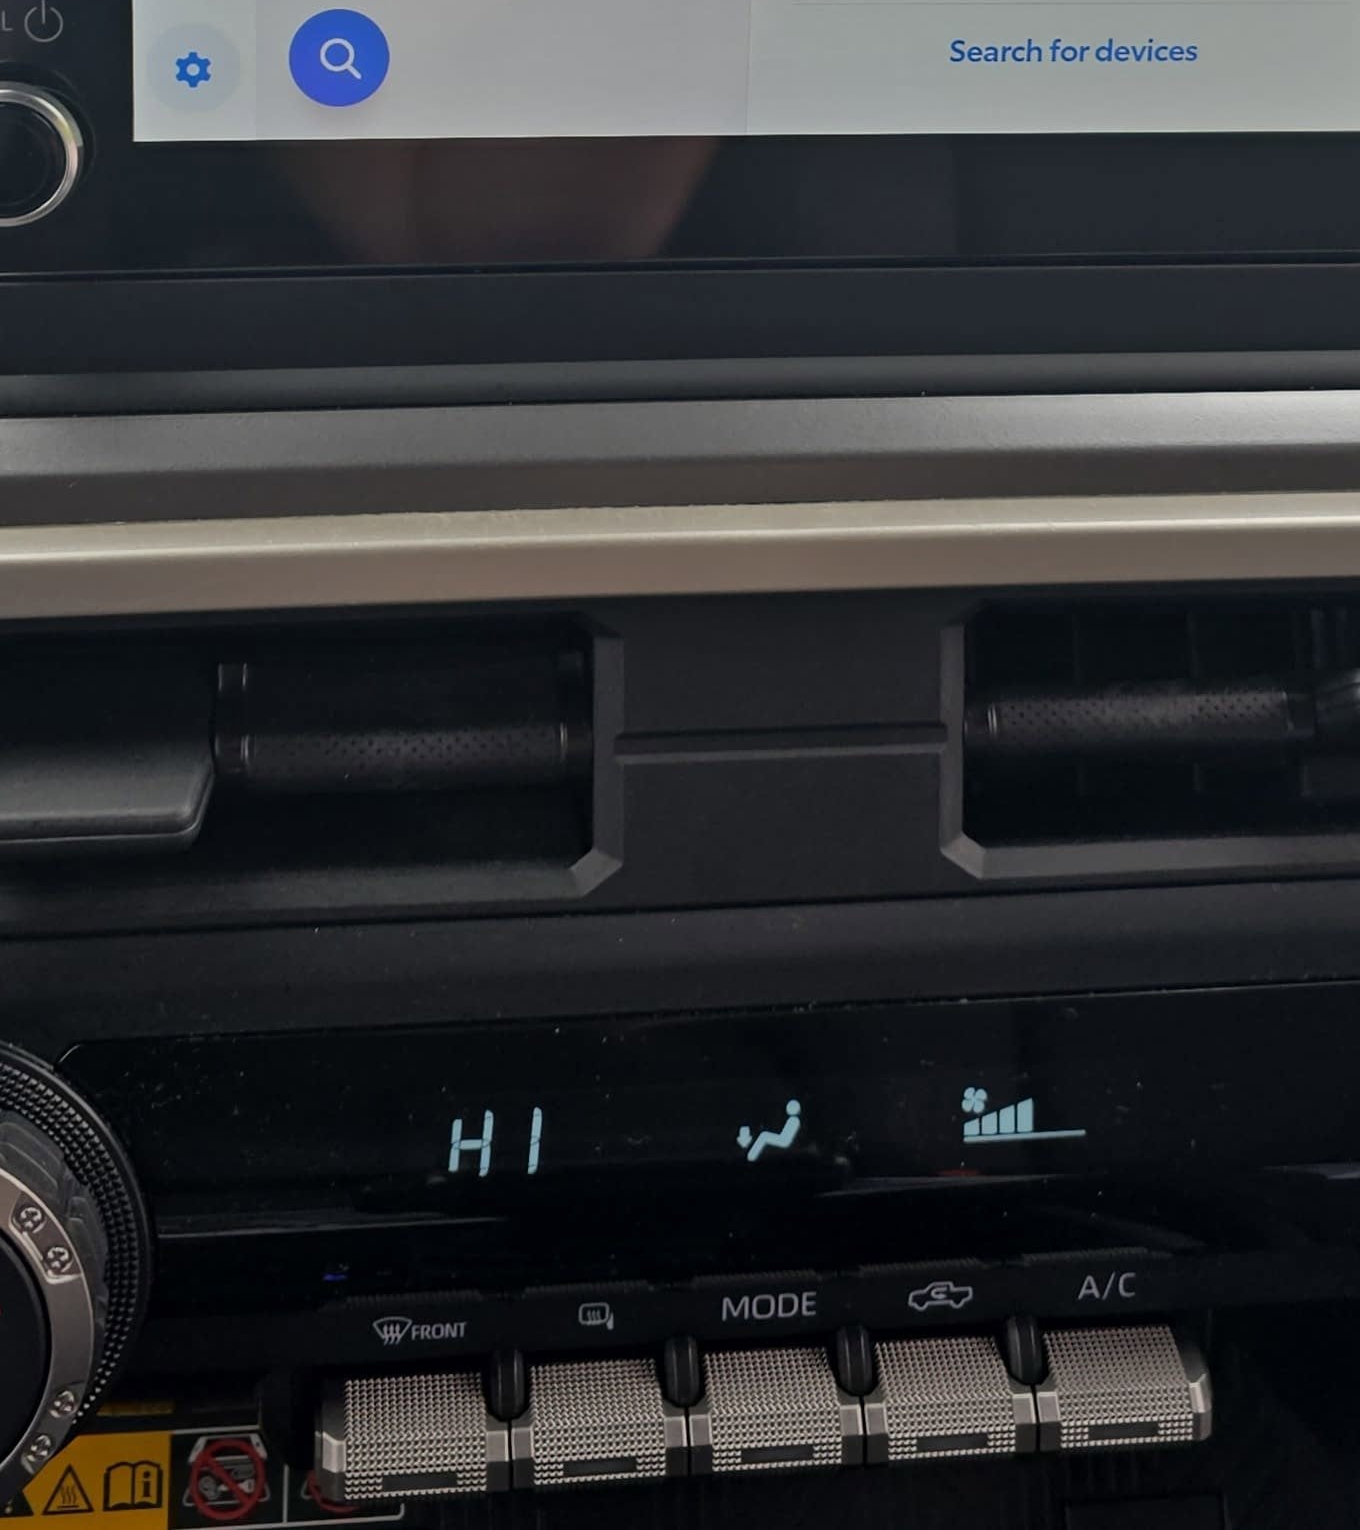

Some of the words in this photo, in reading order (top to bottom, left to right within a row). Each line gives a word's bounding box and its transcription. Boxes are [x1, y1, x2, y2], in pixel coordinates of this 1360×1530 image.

[949, 38, 1044, 64] Search
[1049, 38, 1092, 64] for
[1095, 36, 1199, 63] devices
[447, 1108, 545, 1178] HI
[1077, 1272, 1136, 1301] A/C
[721, 1291, 818, 1322] MODE
[409, 1320, 467, 1341] FRONT
